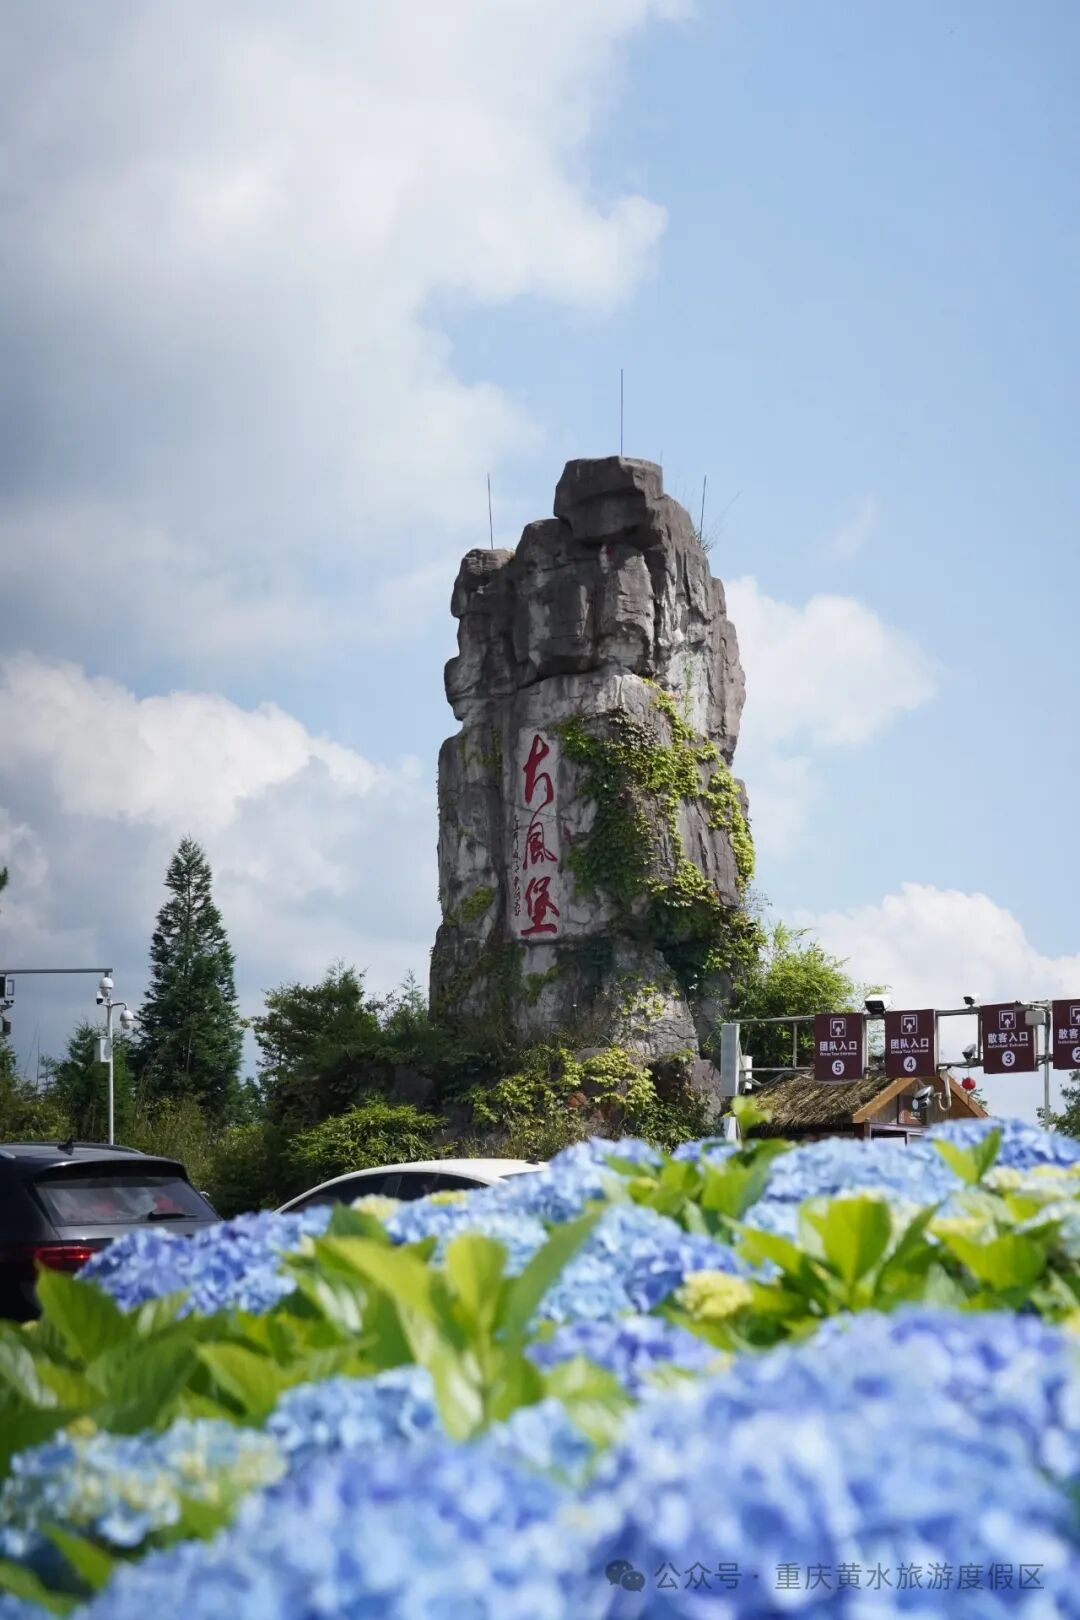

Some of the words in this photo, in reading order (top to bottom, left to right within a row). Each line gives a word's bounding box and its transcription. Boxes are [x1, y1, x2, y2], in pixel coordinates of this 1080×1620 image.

[987, 1031, 1028, 1043] 散客入口
[819, 1041, 857, 1051] 团队入口
[890, 1038, 929, 1049] 团队入口
[906, 1058, 914, 1069] 4
[1005, 1053, 1012, 1064] 3
[835, 1062, 842, 1072] 5
